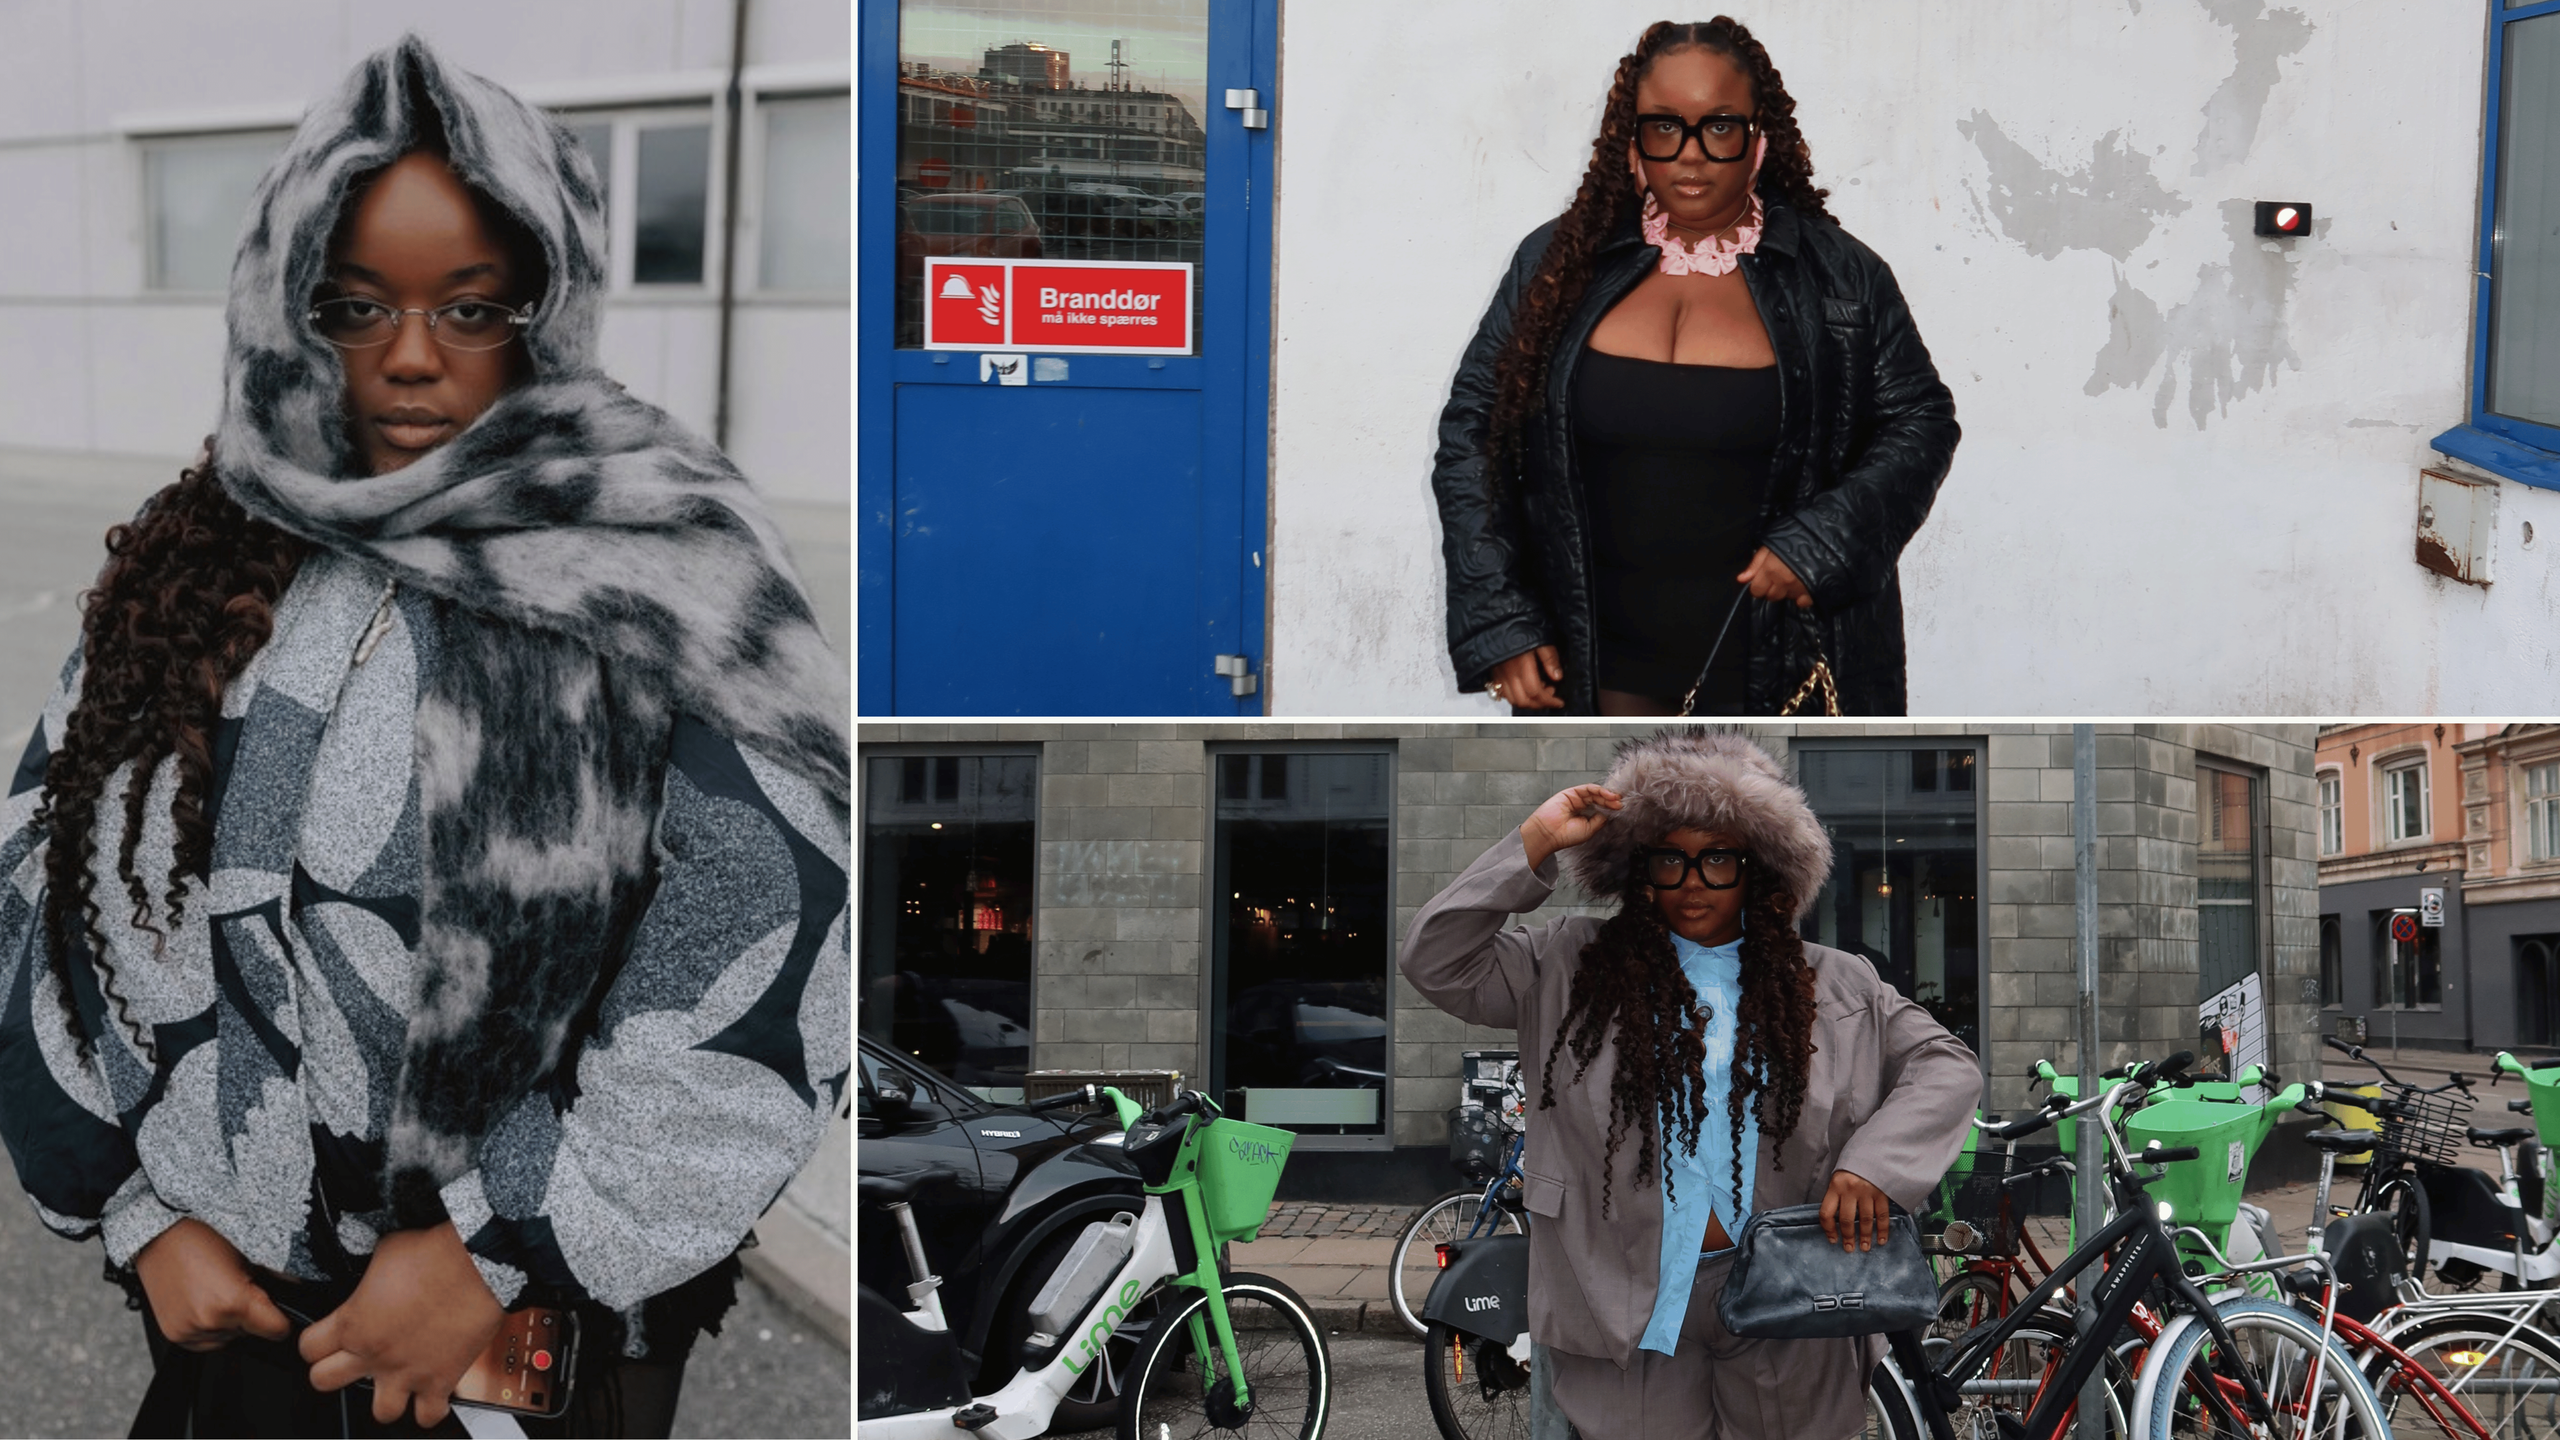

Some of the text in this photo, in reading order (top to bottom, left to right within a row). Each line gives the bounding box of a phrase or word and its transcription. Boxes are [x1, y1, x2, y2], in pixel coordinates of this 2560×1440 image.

[1040, 287, 1161, 311] Branddør
[1041, 310, 1158, 328] må ikke spærres
[2110, 1245, 2142, 1289] SWAPFIETS
[1464, 1295, 1501, 1312] Lime
[1062, 1279, 1142, 1375] Lime
